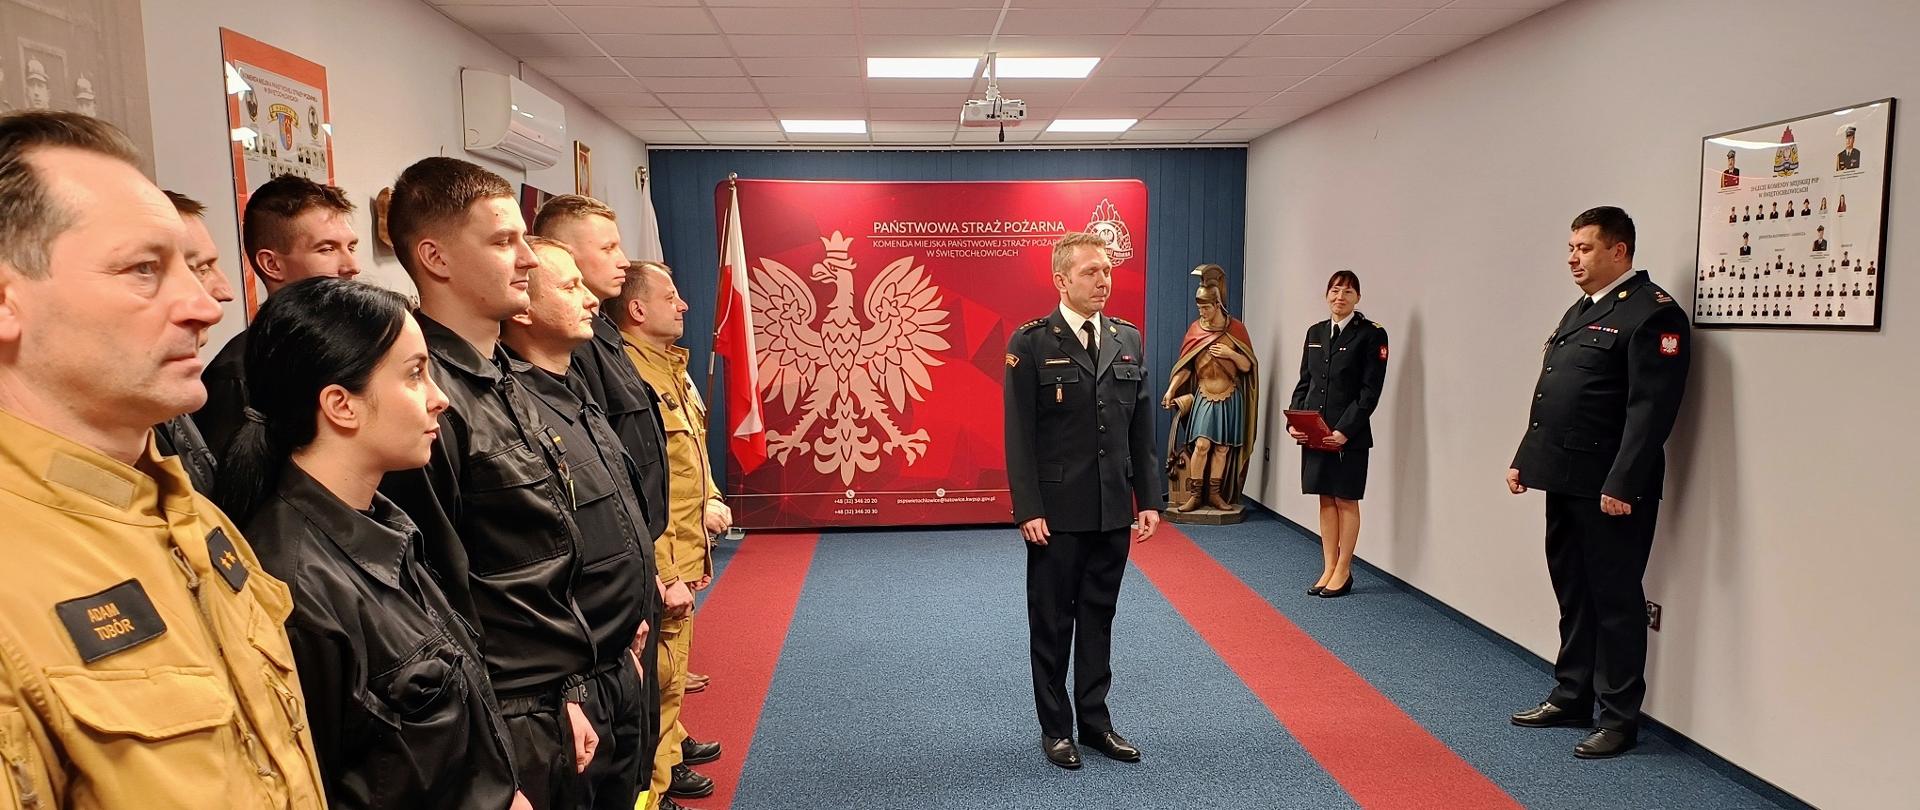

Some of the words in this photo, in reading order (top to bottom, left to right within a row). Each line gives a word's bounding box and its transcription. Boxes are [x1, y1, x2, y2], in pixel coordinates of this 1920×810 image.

[873, 219, 960, 233] PAŃSTWOWA
[961, 218, 1001, 233] STRAŻ
[1004, 219, 1065, 233] POŻARNA
[873, 240, 913, 248] KOMENDA
[914, 240, 947, 248] MIEJSKA
[947, 238, 1001, 248] PAŃSTWOWEJ
[1002, 238, 1031, 247] STRAŻY
[926, 249, 935, 258] W
[935, 248, 1019, 258] ŚWIĘTOCHŁOWICACH
[87, 602, 120, 623] ADAM
[93, 618, 135, 641] TOBÓR
